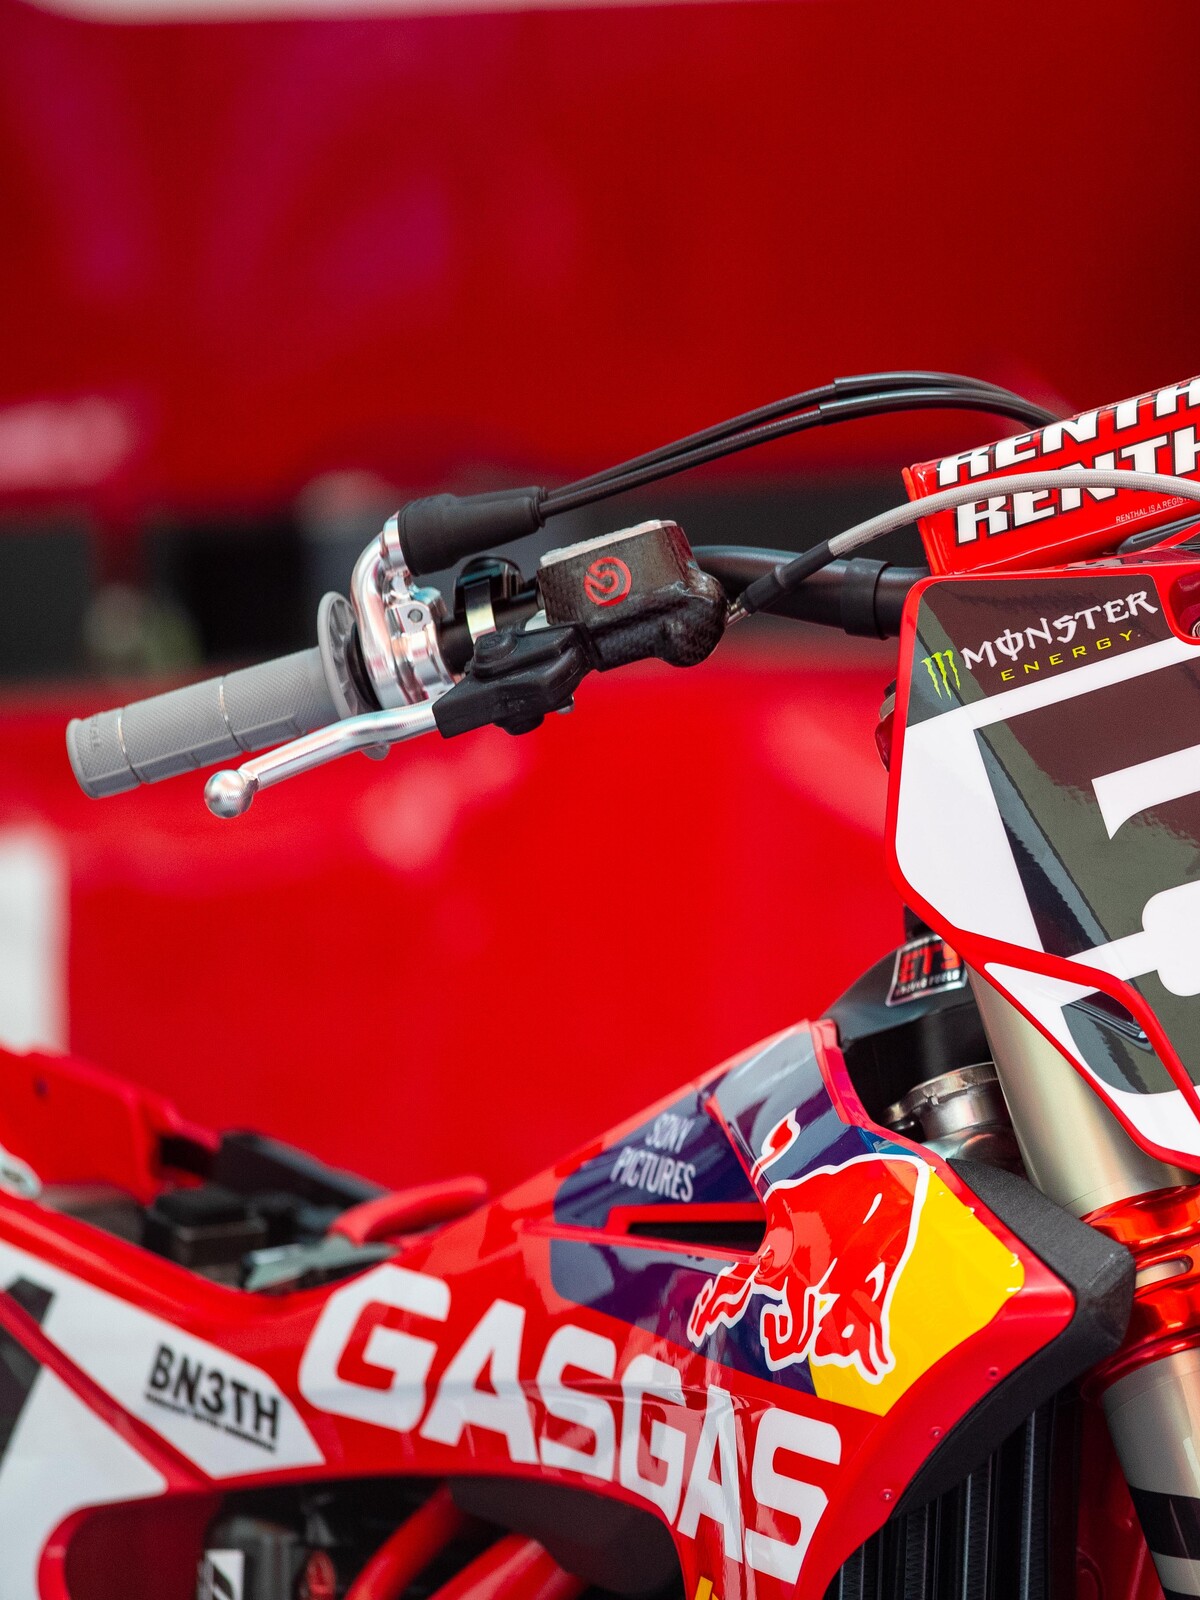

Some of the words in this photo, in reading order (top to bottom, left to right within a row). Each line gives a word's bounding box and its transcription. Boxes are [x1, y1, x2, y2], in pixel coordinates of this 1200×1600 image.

[1115, 507, 1149, 524] RENTHAL
[960, 590, 1159, 670] MONSTER
[1000, 629, 1134, 682] ENERGY
[610, 1146, 696, 1203] PICTURES
[149, 1341, 279, 1440] BN3TH
[298, 1264, 842, 1585] GASGAS
